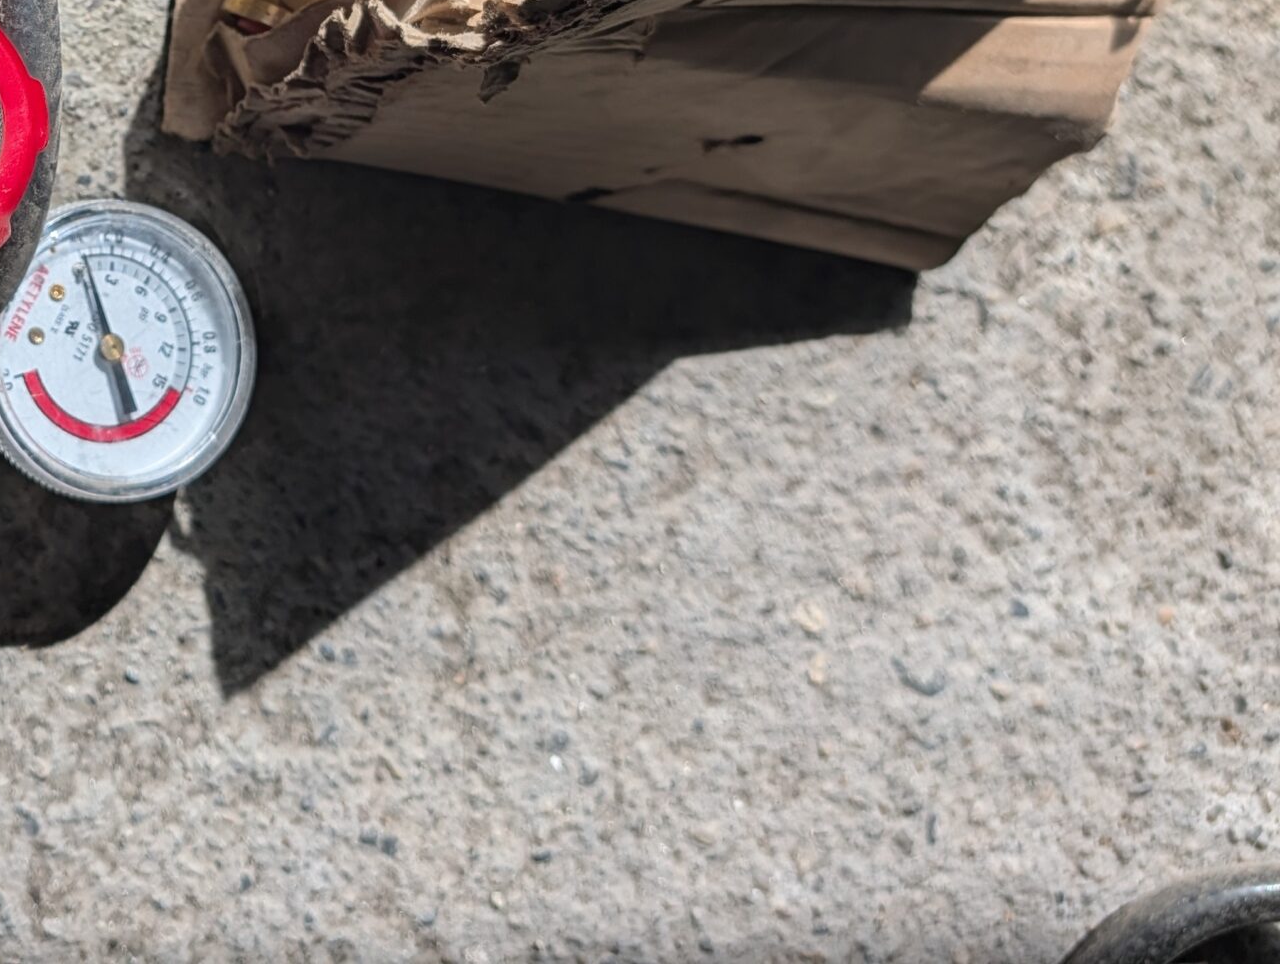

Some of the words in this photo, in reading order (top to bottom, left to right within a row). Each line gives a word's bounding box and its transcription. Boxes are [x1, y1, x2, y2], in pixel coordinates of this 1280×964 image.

[105, 273, 119, 286] 3
[134, 285, 149, 298] 6
[4, 264, 49, 342] ACETYLENE
[154, 311, 168, 324] 9
[72, 333, 94, 363] 5171
[158, 341, 174, 358] 12
[151, 373, 169, 390] 15
